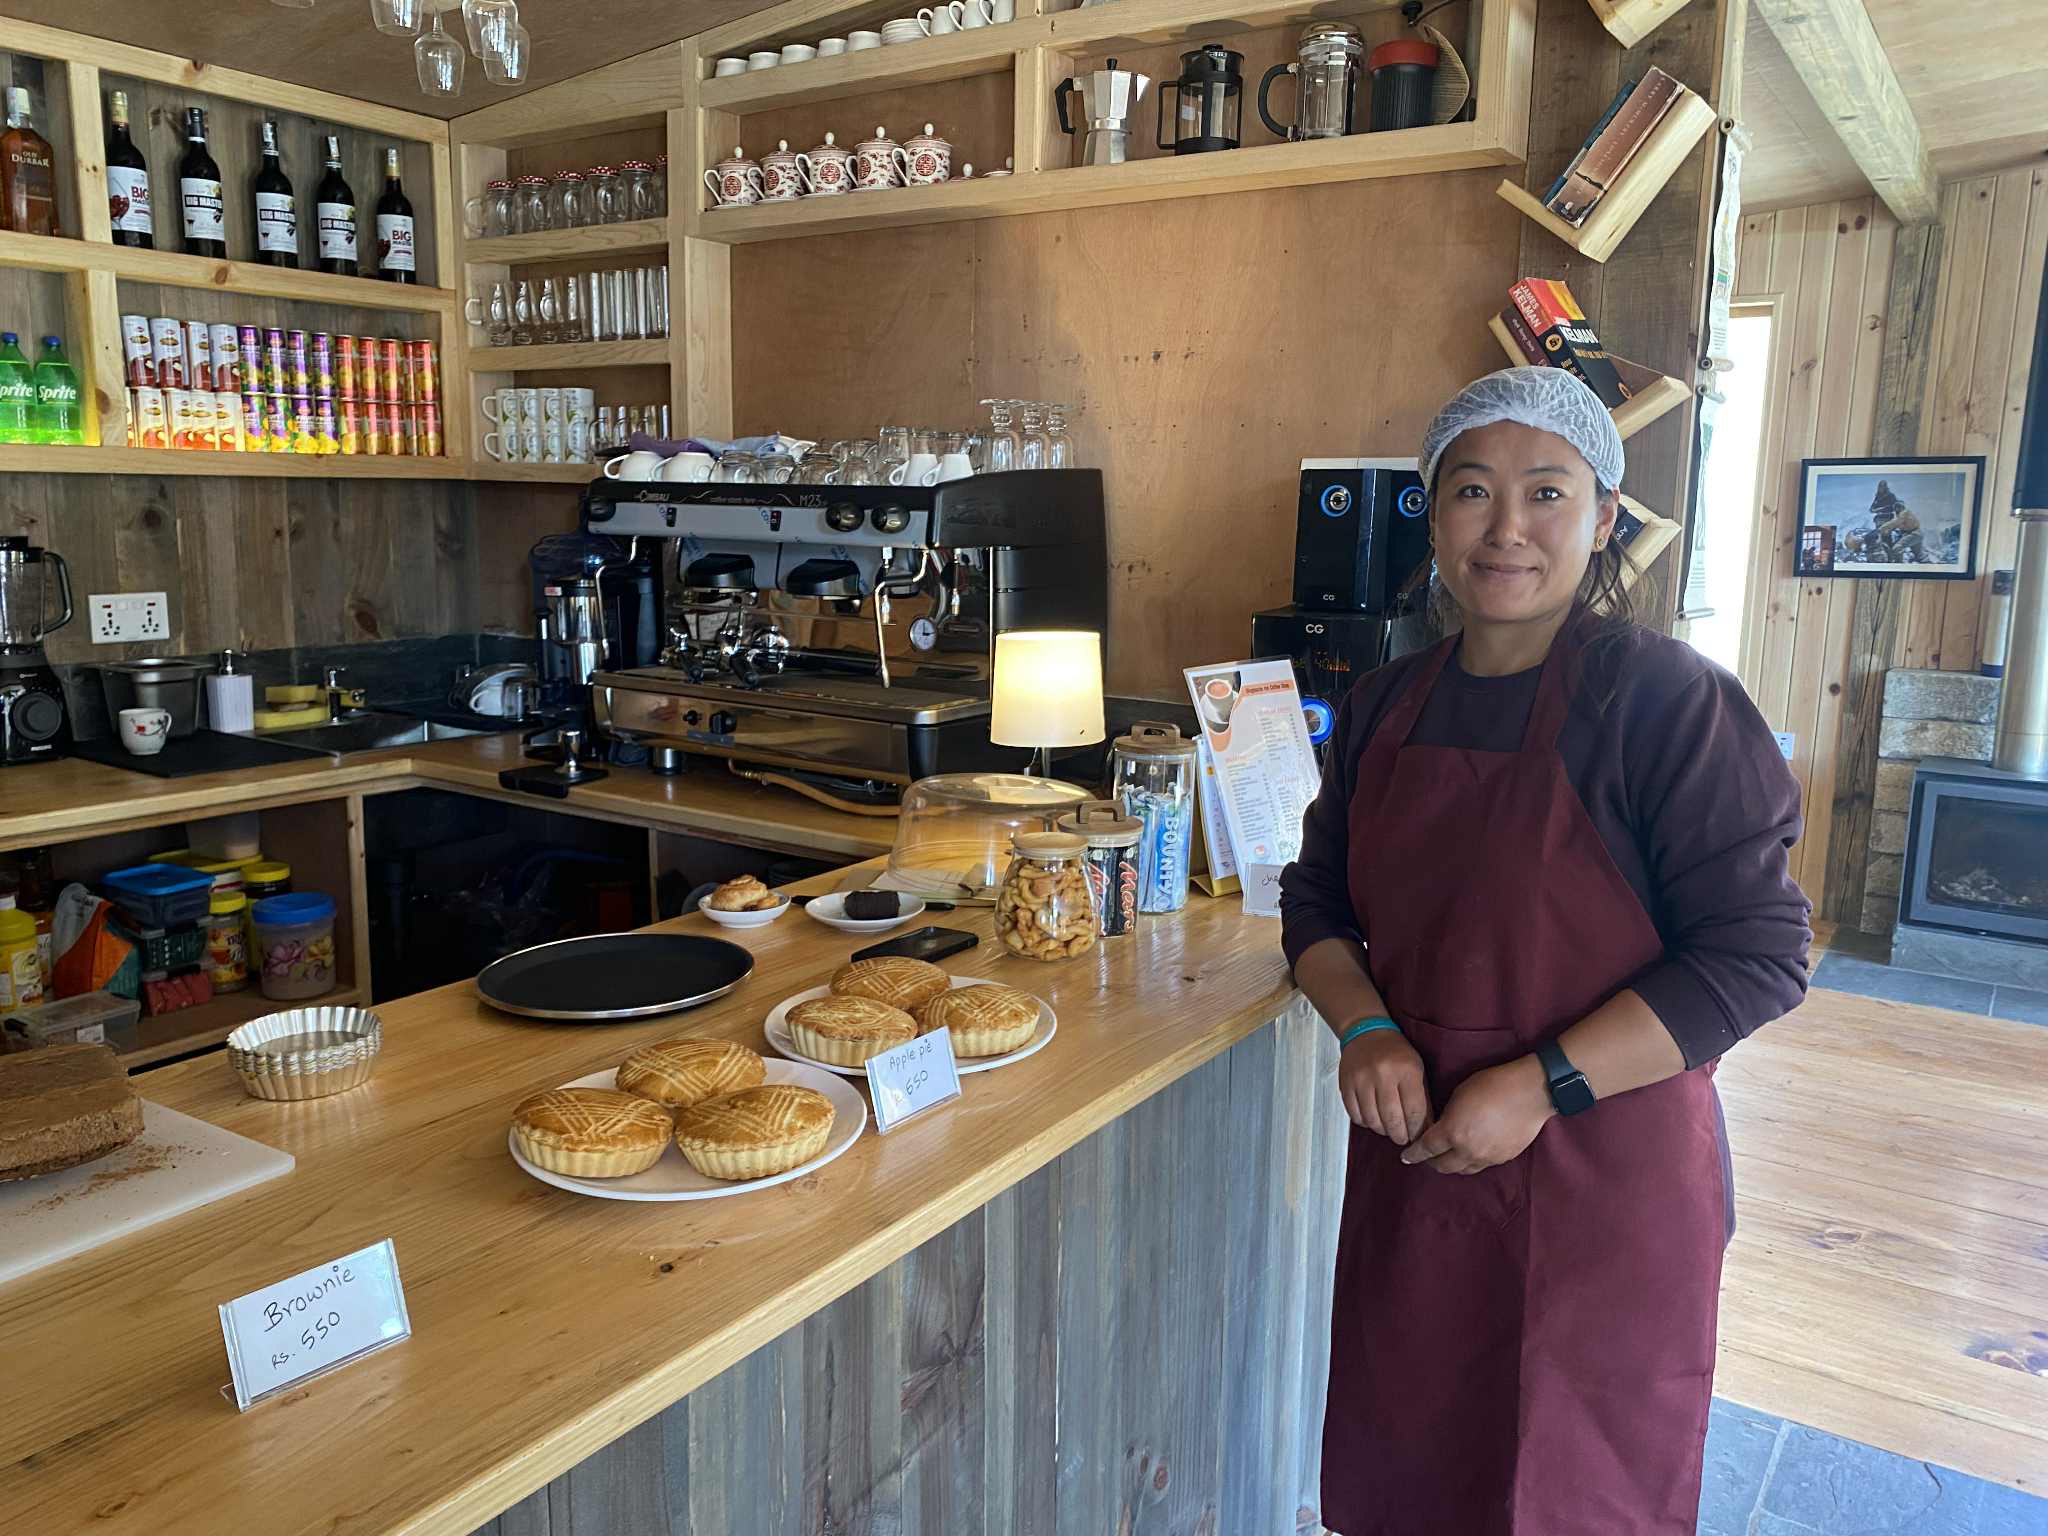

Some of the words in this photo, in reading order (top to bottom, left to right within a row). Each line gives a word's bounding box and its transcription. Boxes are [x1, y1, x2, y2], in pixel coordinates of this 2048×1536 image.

[11, 153, 49, 168] DURBAR
[392, 230, 411, 242] BIG
[1513, 288, 1542, 328] KELMAN
[1520, 285, 1539, 310] JAMES
[1559, 326, 1599, 344] KELMAN
[0, 382, 33, 399] prite
[38, 384, 77, 402] Sprite
[1305, 623, 1325, 634] CG
[1159, 816, 1179, 896] BOUNTY
[1118, 861, 1138, 935] Mars
[889, 1048, 916, 1073] Apple
[919, 1038, 934, 1065] pie
[905, 1069, 929, 1096] 650
[263, 1265, 356, 1333] Brownie
[301, 1311, 340, 1350] 550
